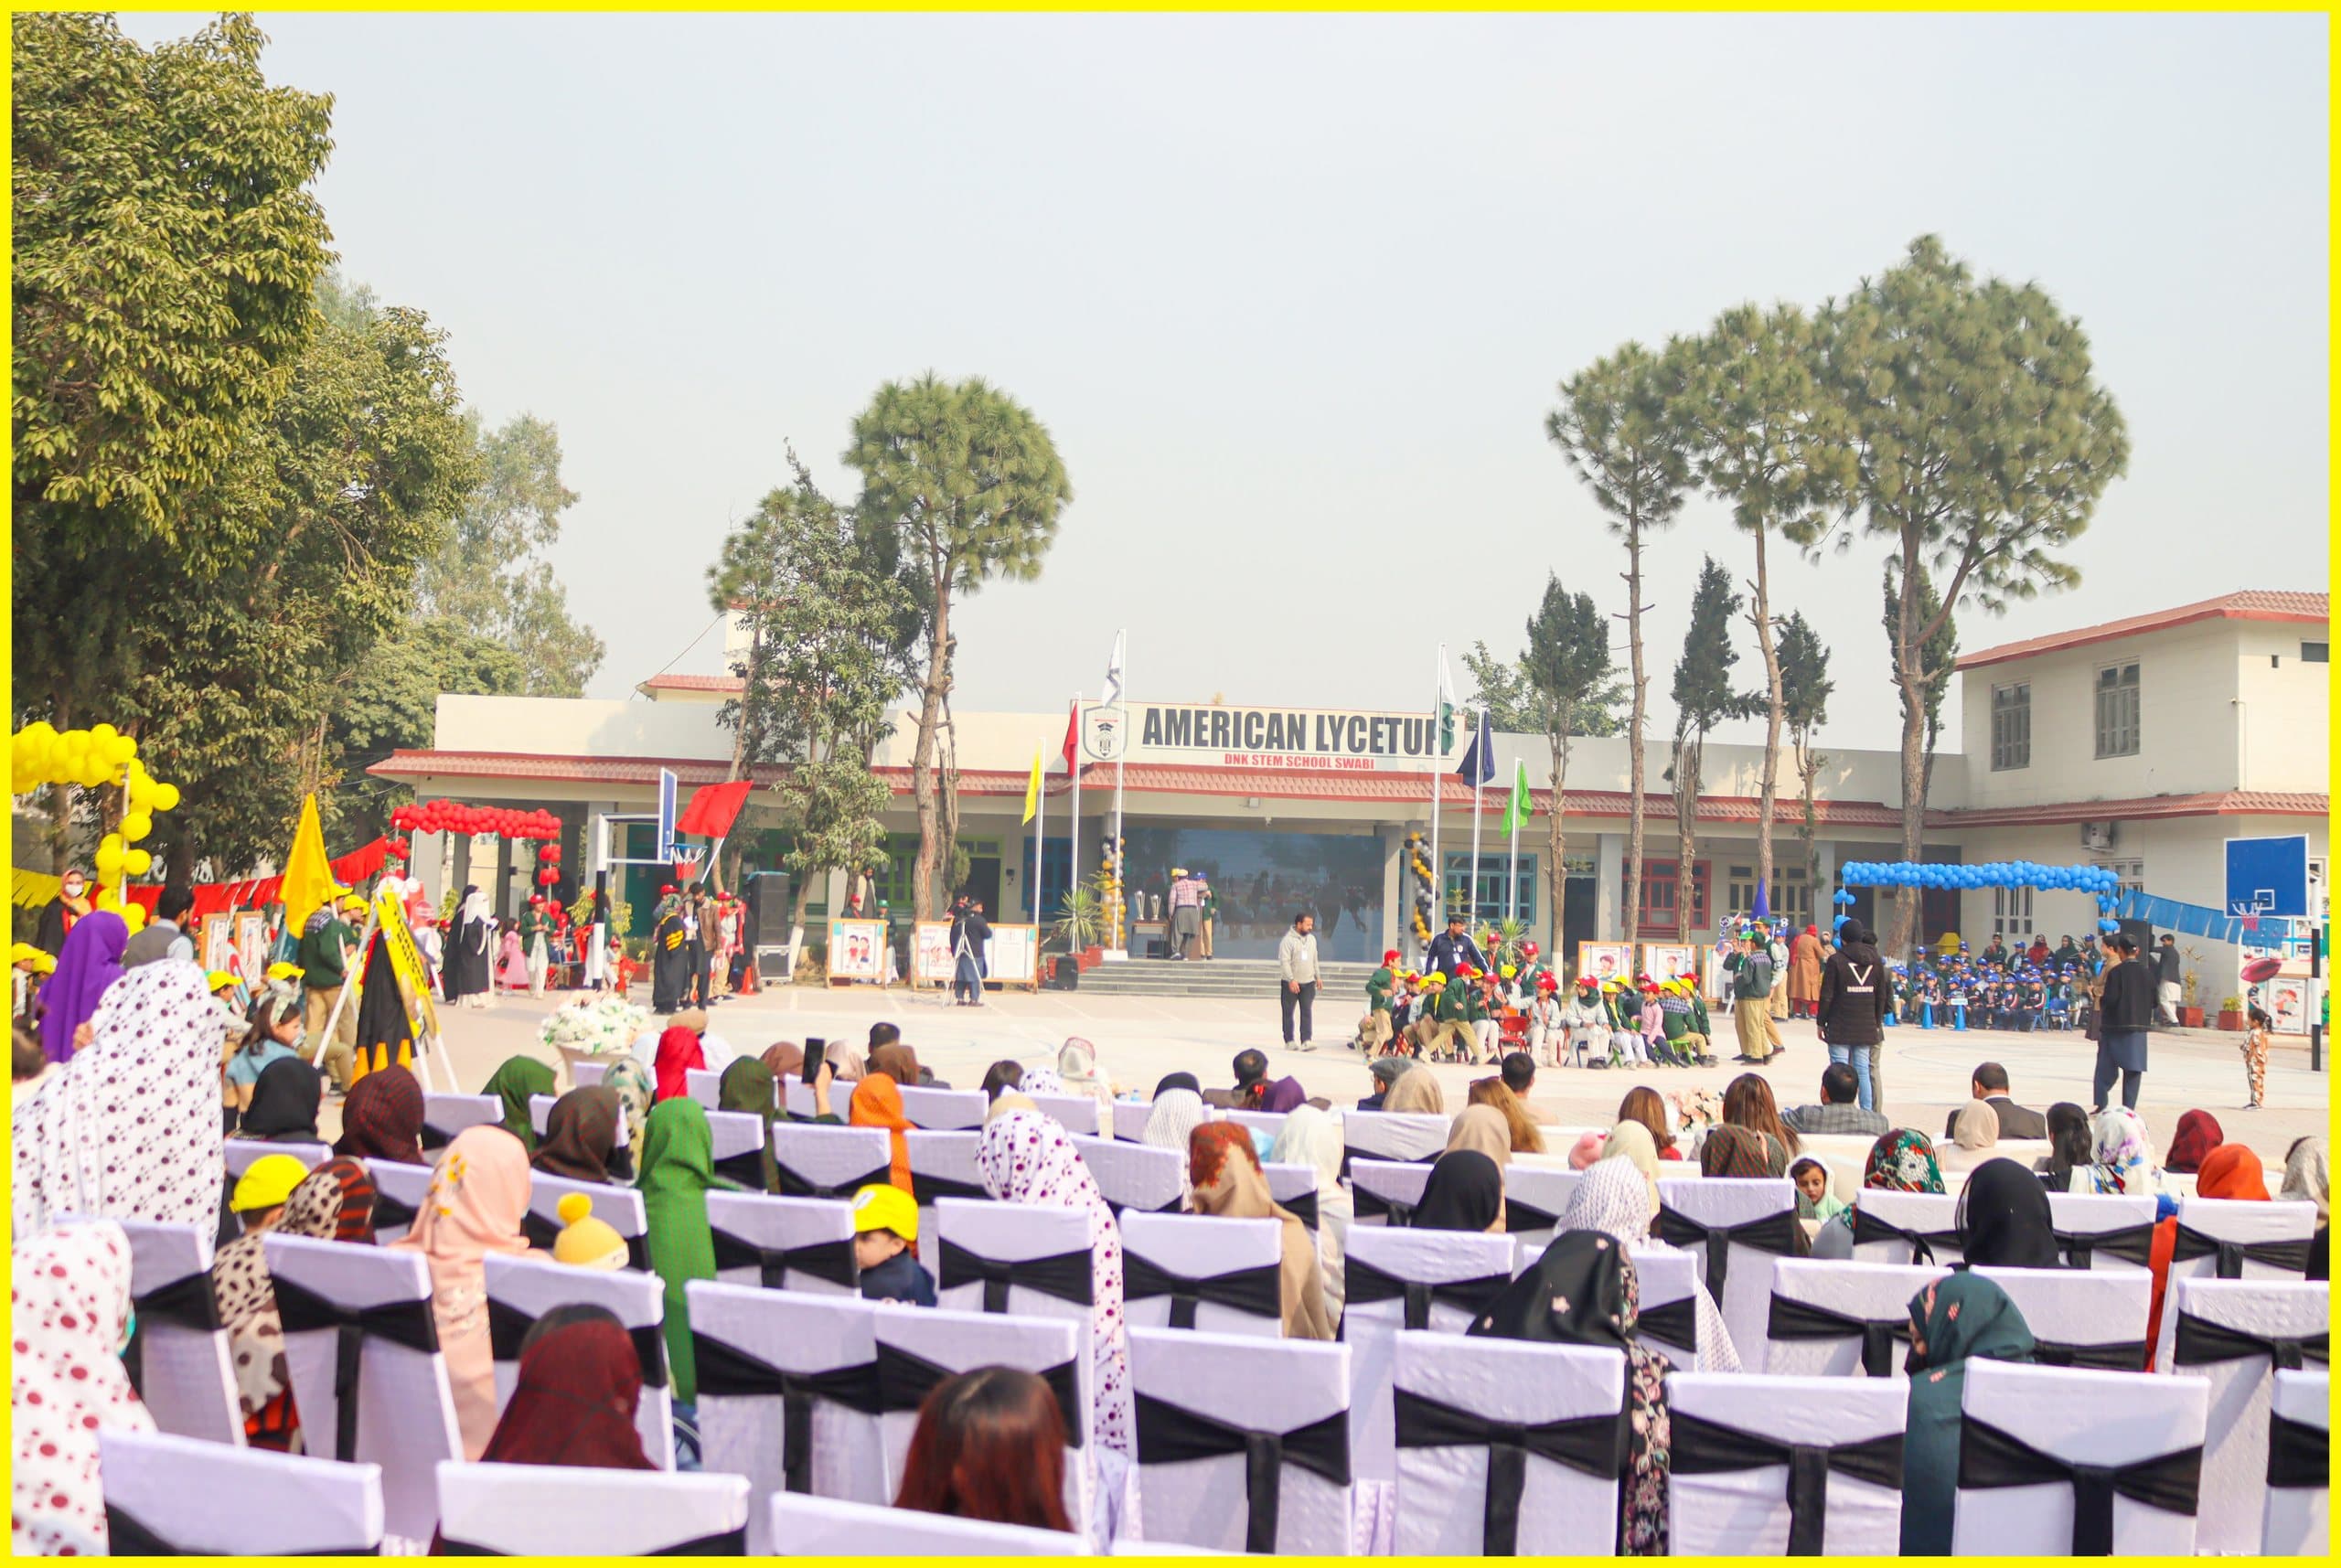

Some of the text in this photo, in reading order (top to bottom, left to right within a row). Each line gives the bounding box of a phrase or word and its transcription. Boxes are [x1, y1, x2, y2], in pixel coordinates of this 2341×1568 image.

[1142, 708, 1306, 751] AMERICAN
[1224, 753, 1374, 769] DNK STEM SCHOOL SWABI
